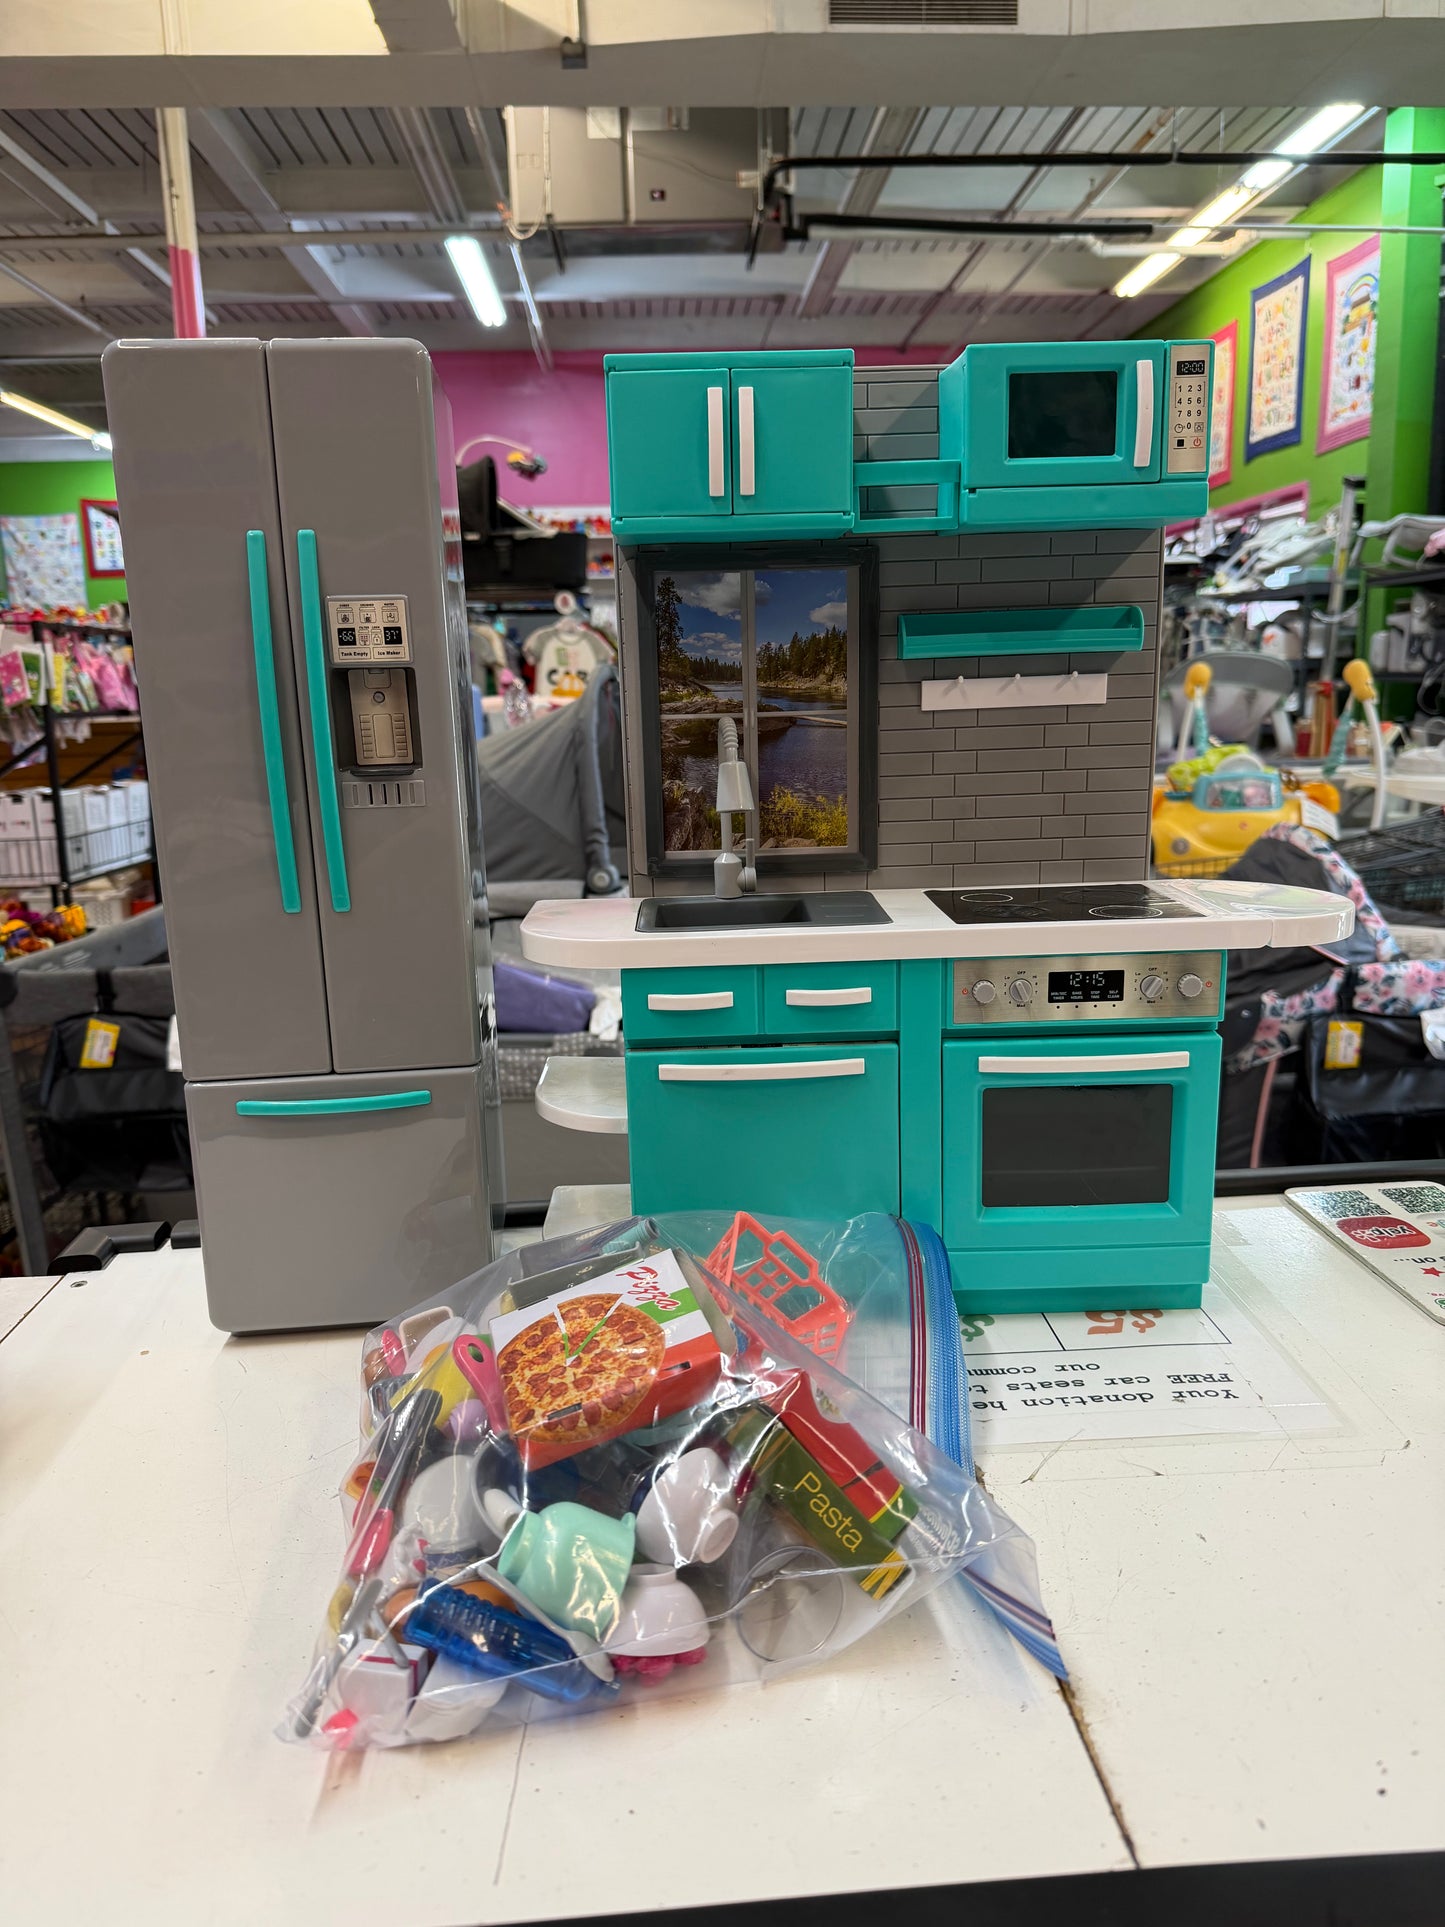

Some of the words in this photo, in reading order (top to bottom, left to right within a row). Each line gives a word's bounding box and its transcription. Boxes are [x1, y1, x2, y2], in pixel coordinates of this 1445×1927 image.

[1181, 362, 1204, 373] 12:00
[1187, 385, 1192, 393] 2
[1197, 384, 1202, 392] 3
[1177, 397, 1182, 405] 4
[1187, 397, 1192, 405] 5
[1196, 409, 1201, 417] 9
[1186, 422, 1191, 430] 0
[1069, 972, 1105, 987] 12:15
[1370, 1225, 1416, 1238] yelp
[616, 1266, 681, 1311] Pizza
[1054, 1363, 1101, 1372] our
[1104, 1376, 1150, 1386] car
[1167, 1373, 1234, 1384] FREE
[1006, 1379, 1085, 1391] seats
[1020, 1392, 1154, 1408] donation
[1171, 1389, 1239, 1400] Your
[793, 1471, 863, 1553] Pasta
